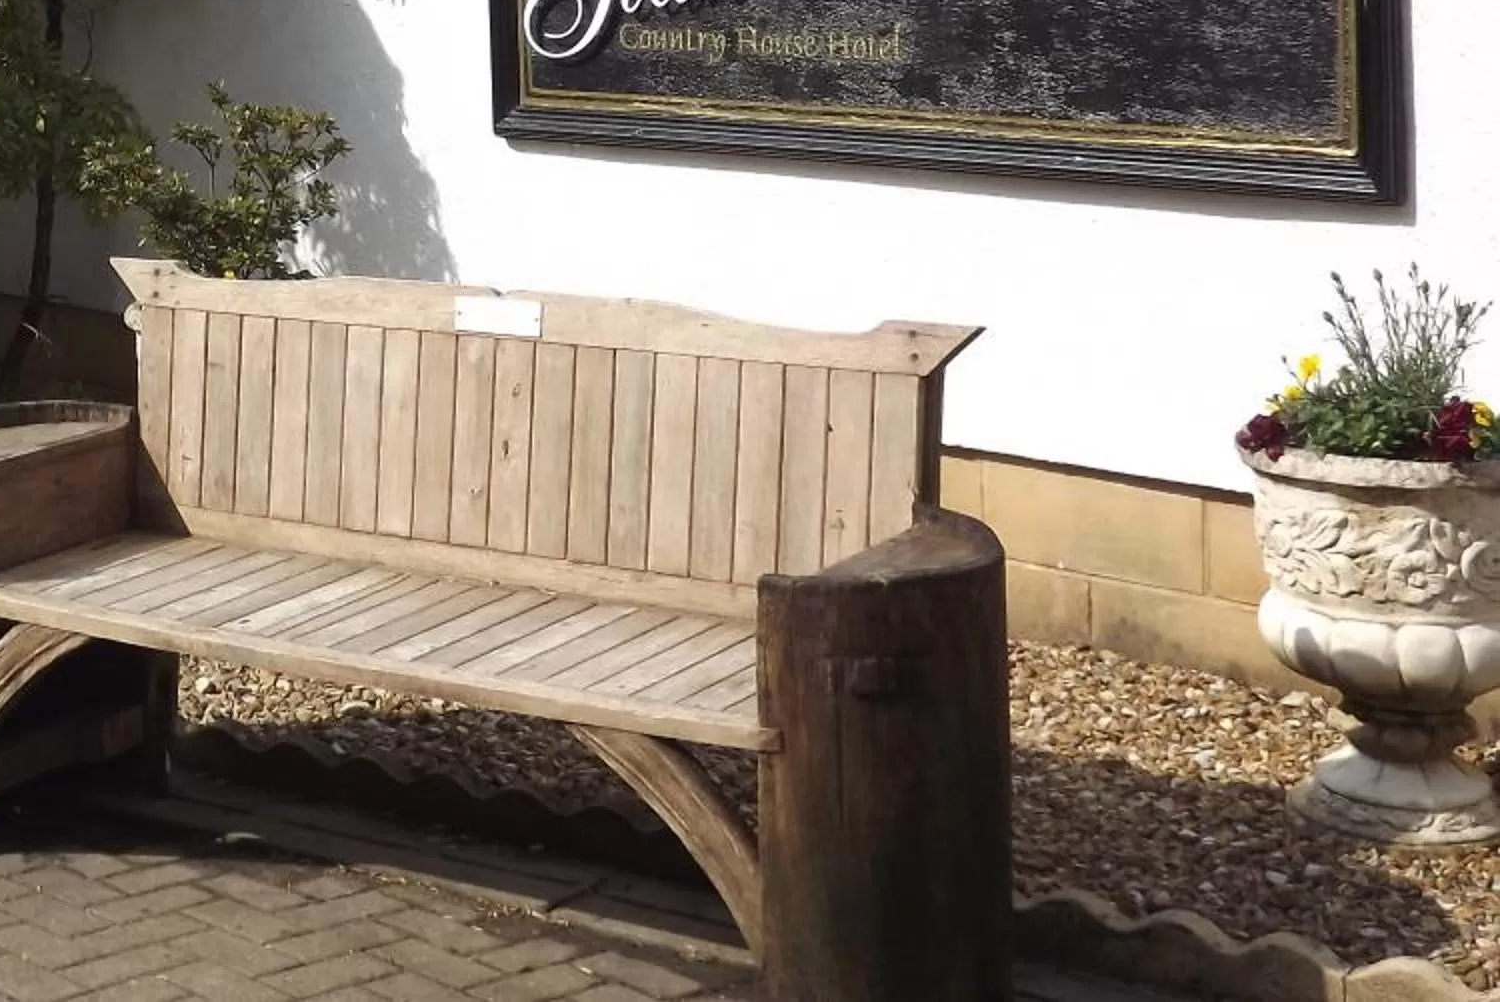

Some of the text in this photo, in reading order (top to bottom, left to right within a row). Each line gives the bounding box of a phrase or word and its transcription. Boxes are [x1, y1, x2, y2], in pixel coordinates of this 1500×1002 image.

[618, 22, 901, 65] Country House Hotel
